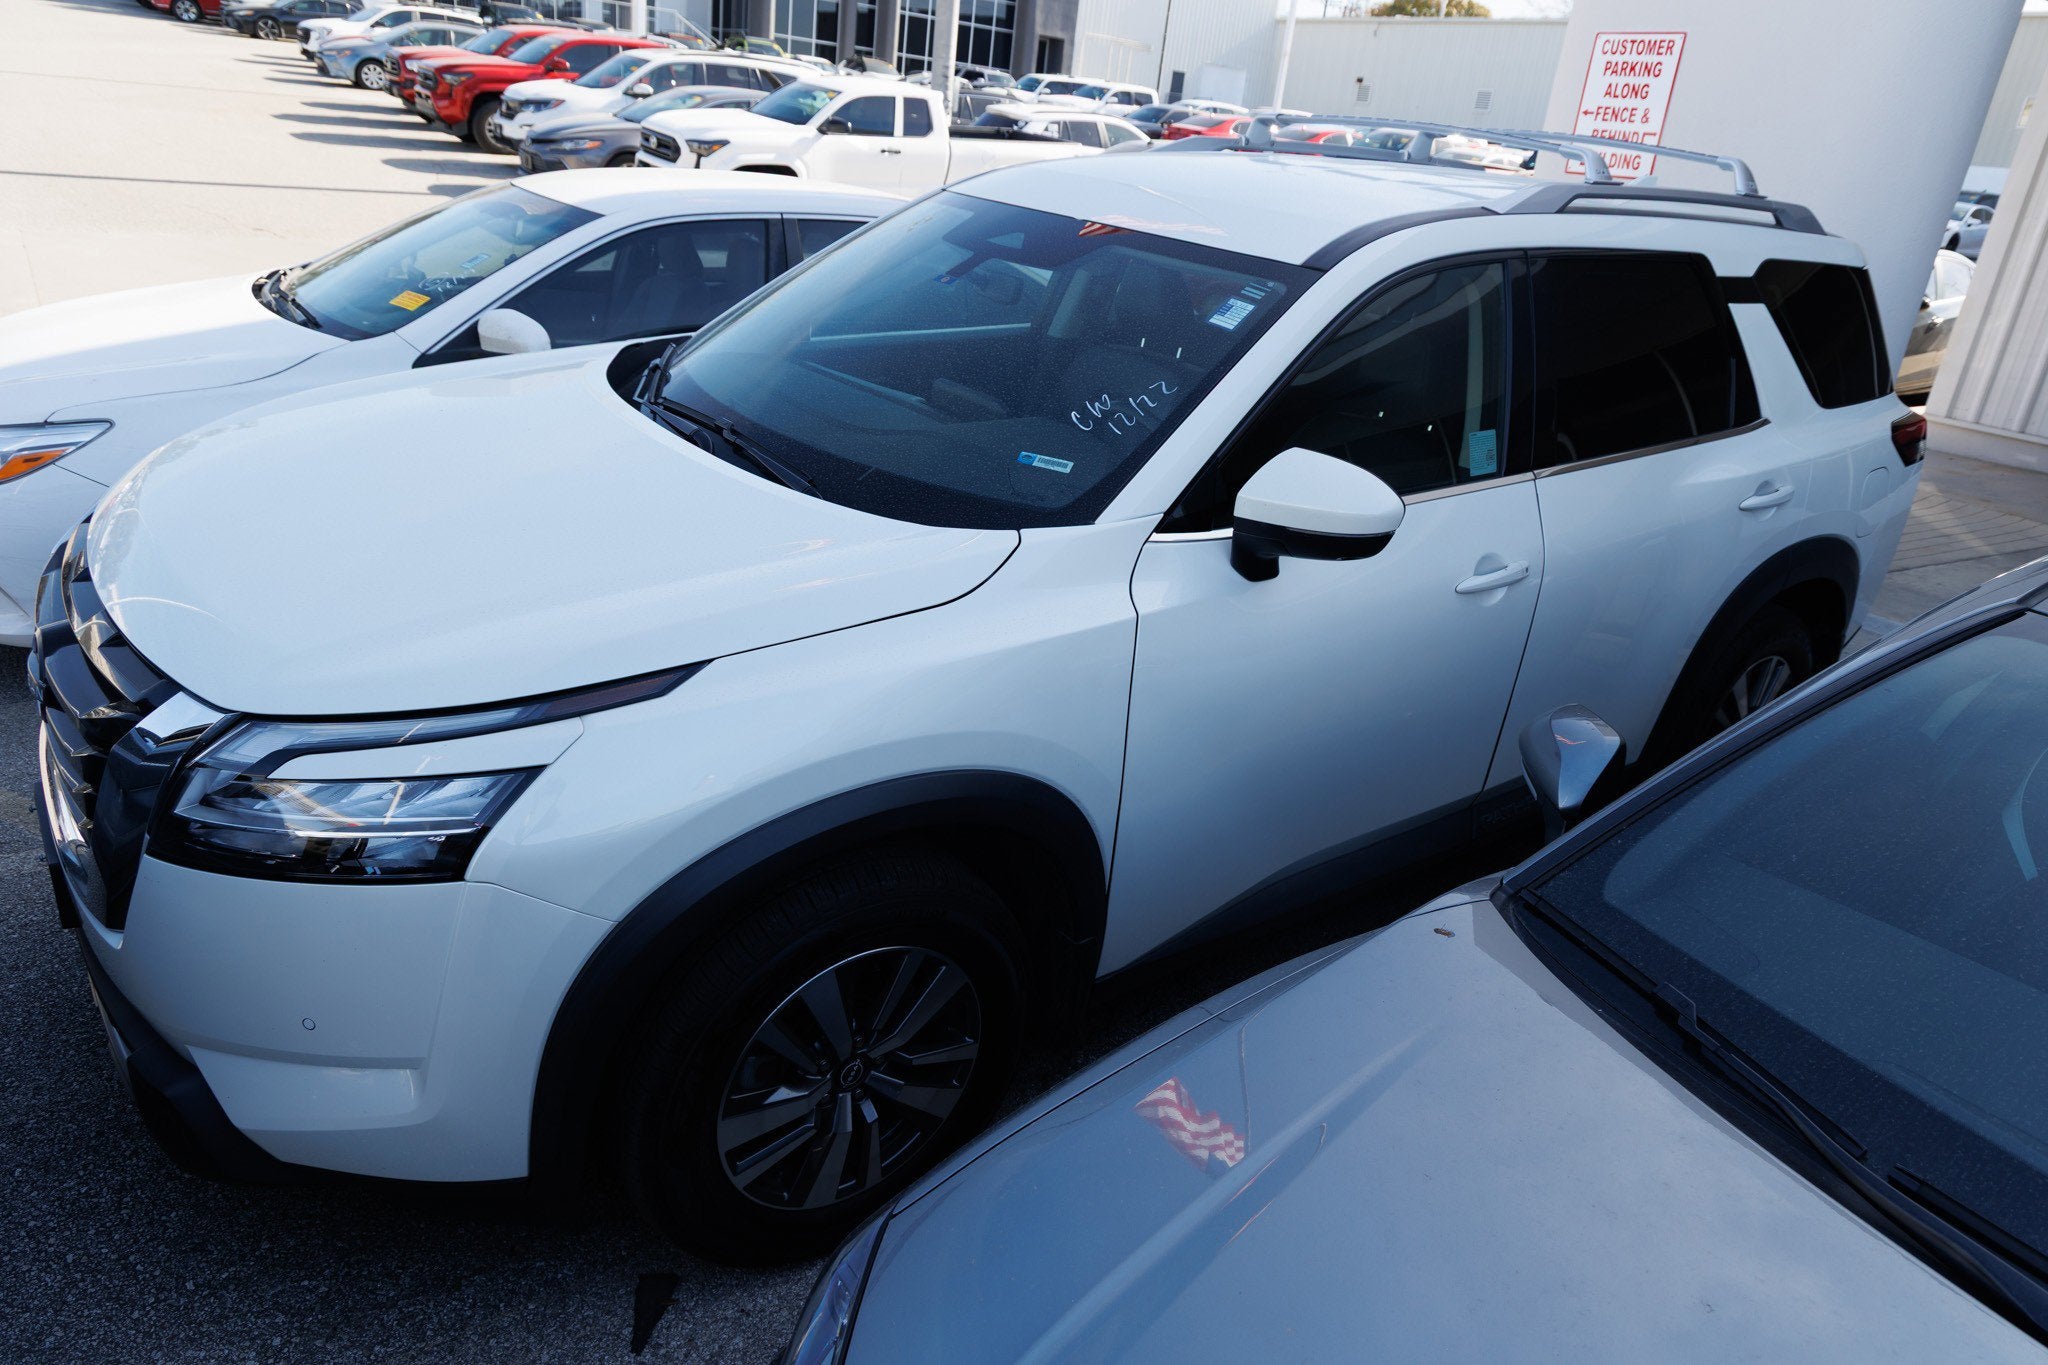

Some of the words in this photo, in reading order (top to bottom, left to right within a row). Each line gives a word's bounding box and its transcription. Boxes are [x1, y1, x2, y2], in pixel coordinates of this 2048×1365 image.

[1602, 39, 1675, 55] CUSTOMER
[1603, 61, 1662, 77] PARKING
[1604, 83, 1649, 99] ALONG
[1594, 106, 1637, 122] FENCE
[1641, 108, 1649, 123] &
